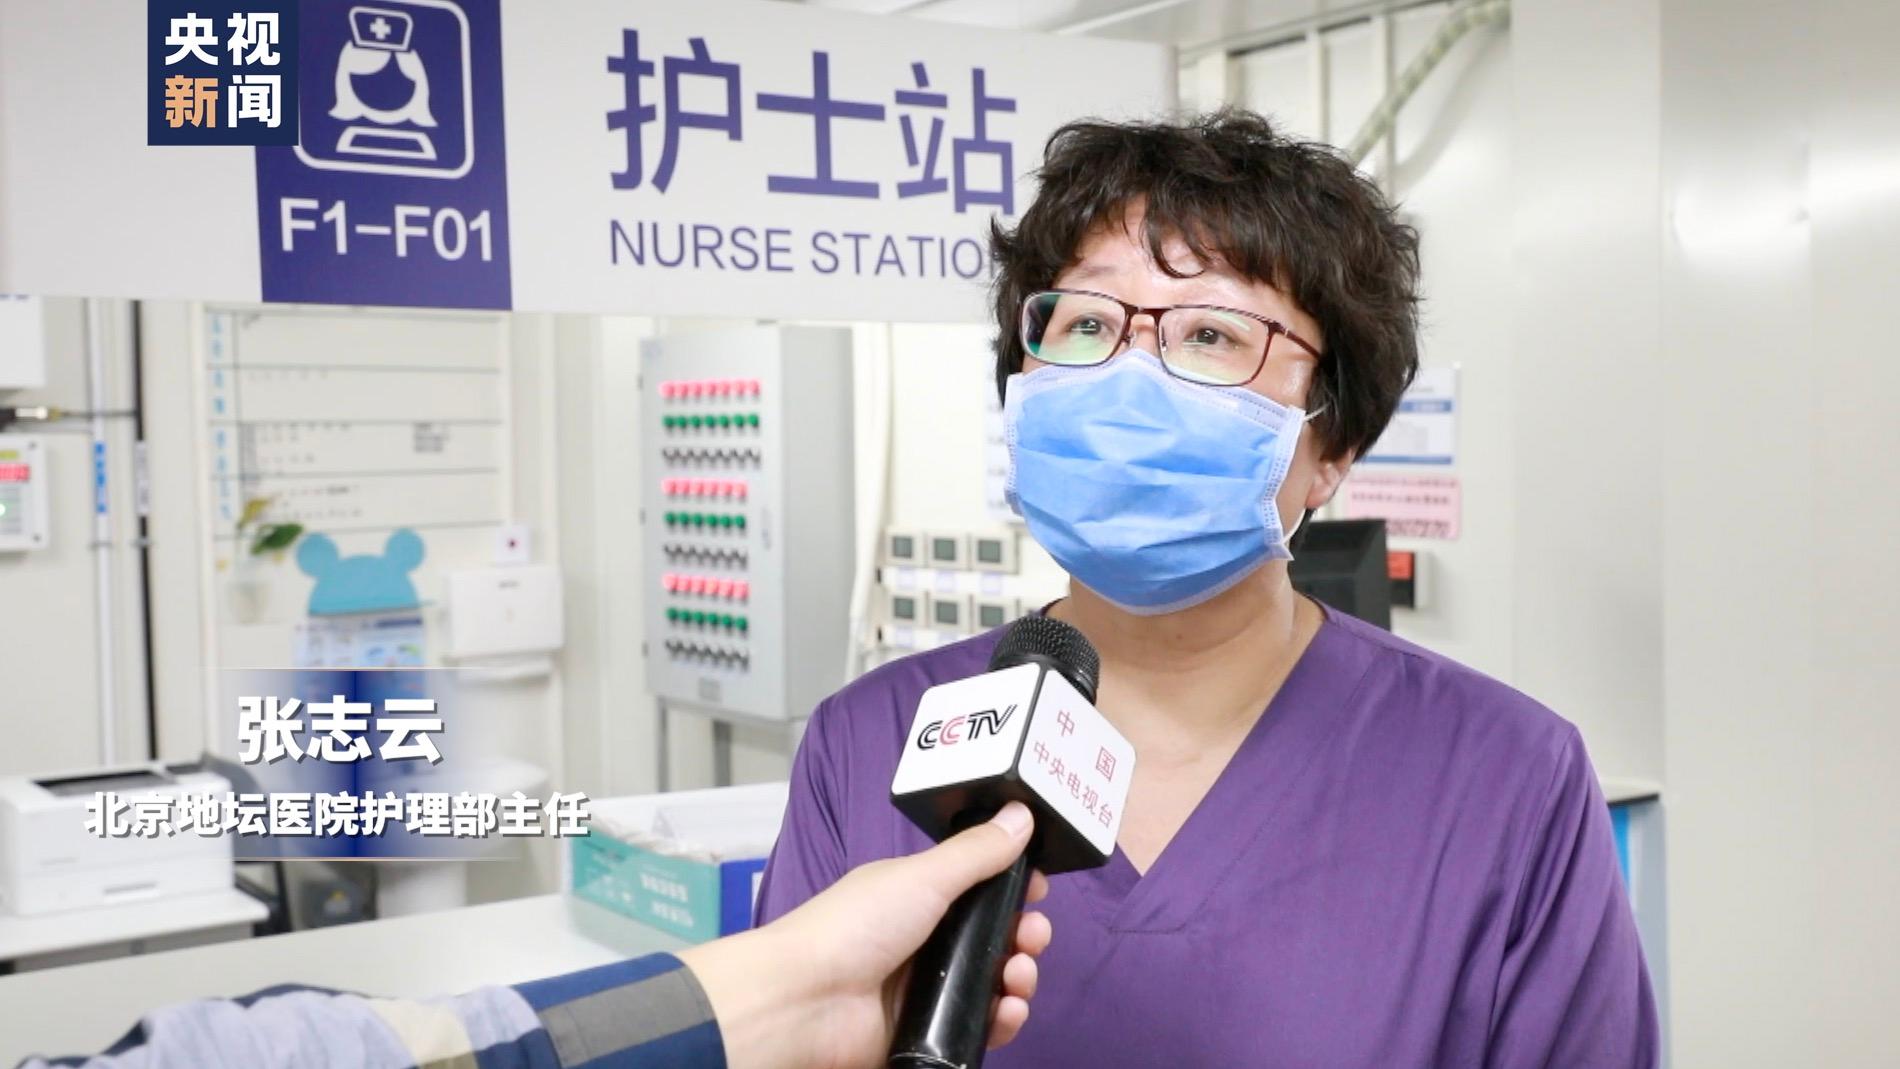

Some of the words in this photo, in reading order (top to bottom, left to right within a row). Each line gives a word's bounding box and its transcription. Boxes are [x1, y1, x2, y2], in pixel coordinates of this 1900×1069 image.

[606, 28, 1017, 216] 护士站
[609, 219, 794, 272] NURSE
[811, 231, 998, 280] STATIO
[917, 704, 1017, 750] CCTV
[1034, 740, 1113, 828] 中央电视台
